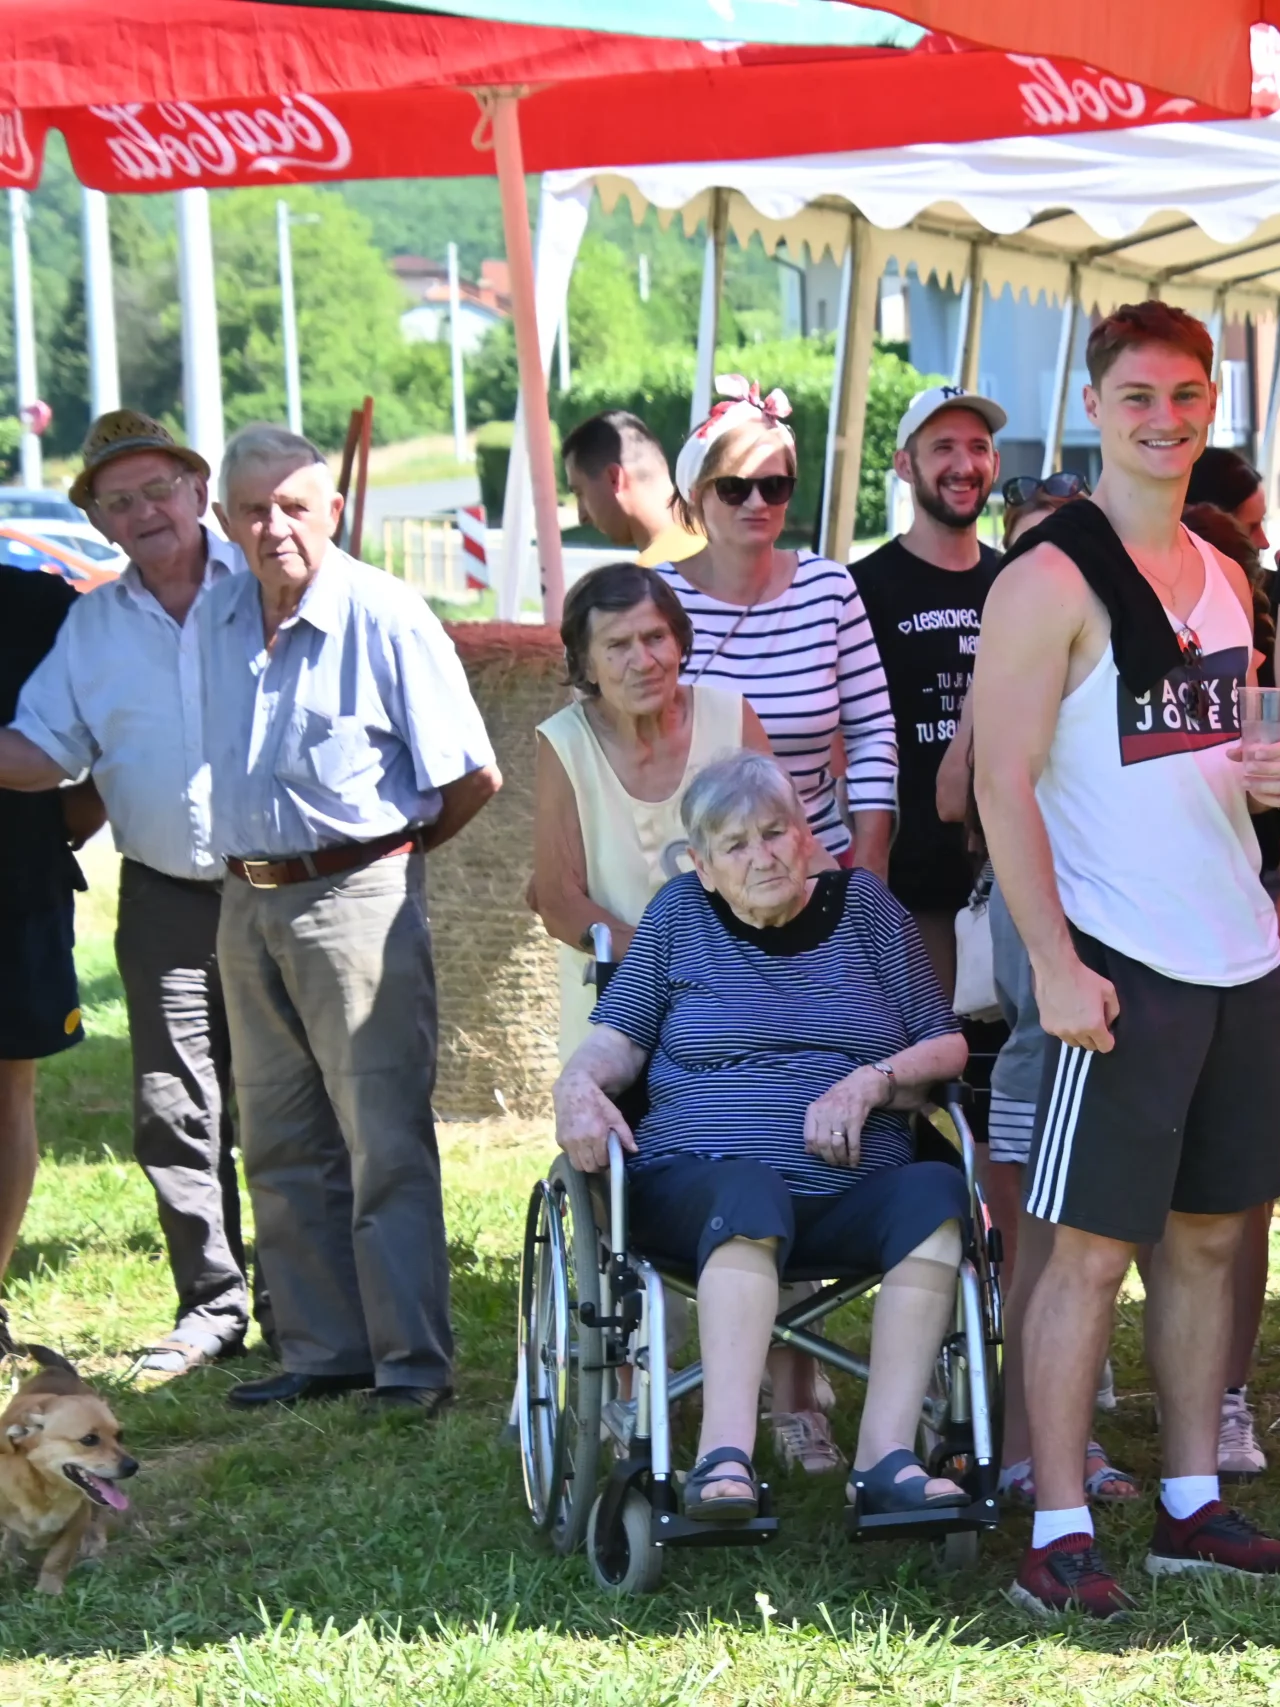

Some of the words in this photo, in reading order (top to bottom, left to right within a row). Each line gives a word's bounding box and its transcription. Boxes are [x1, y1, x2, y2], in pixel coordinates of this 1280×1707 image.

[936, 672, 951, 689] TU
[940, 695, 954, 712] TU
[916, 722, 935, 743] TU
